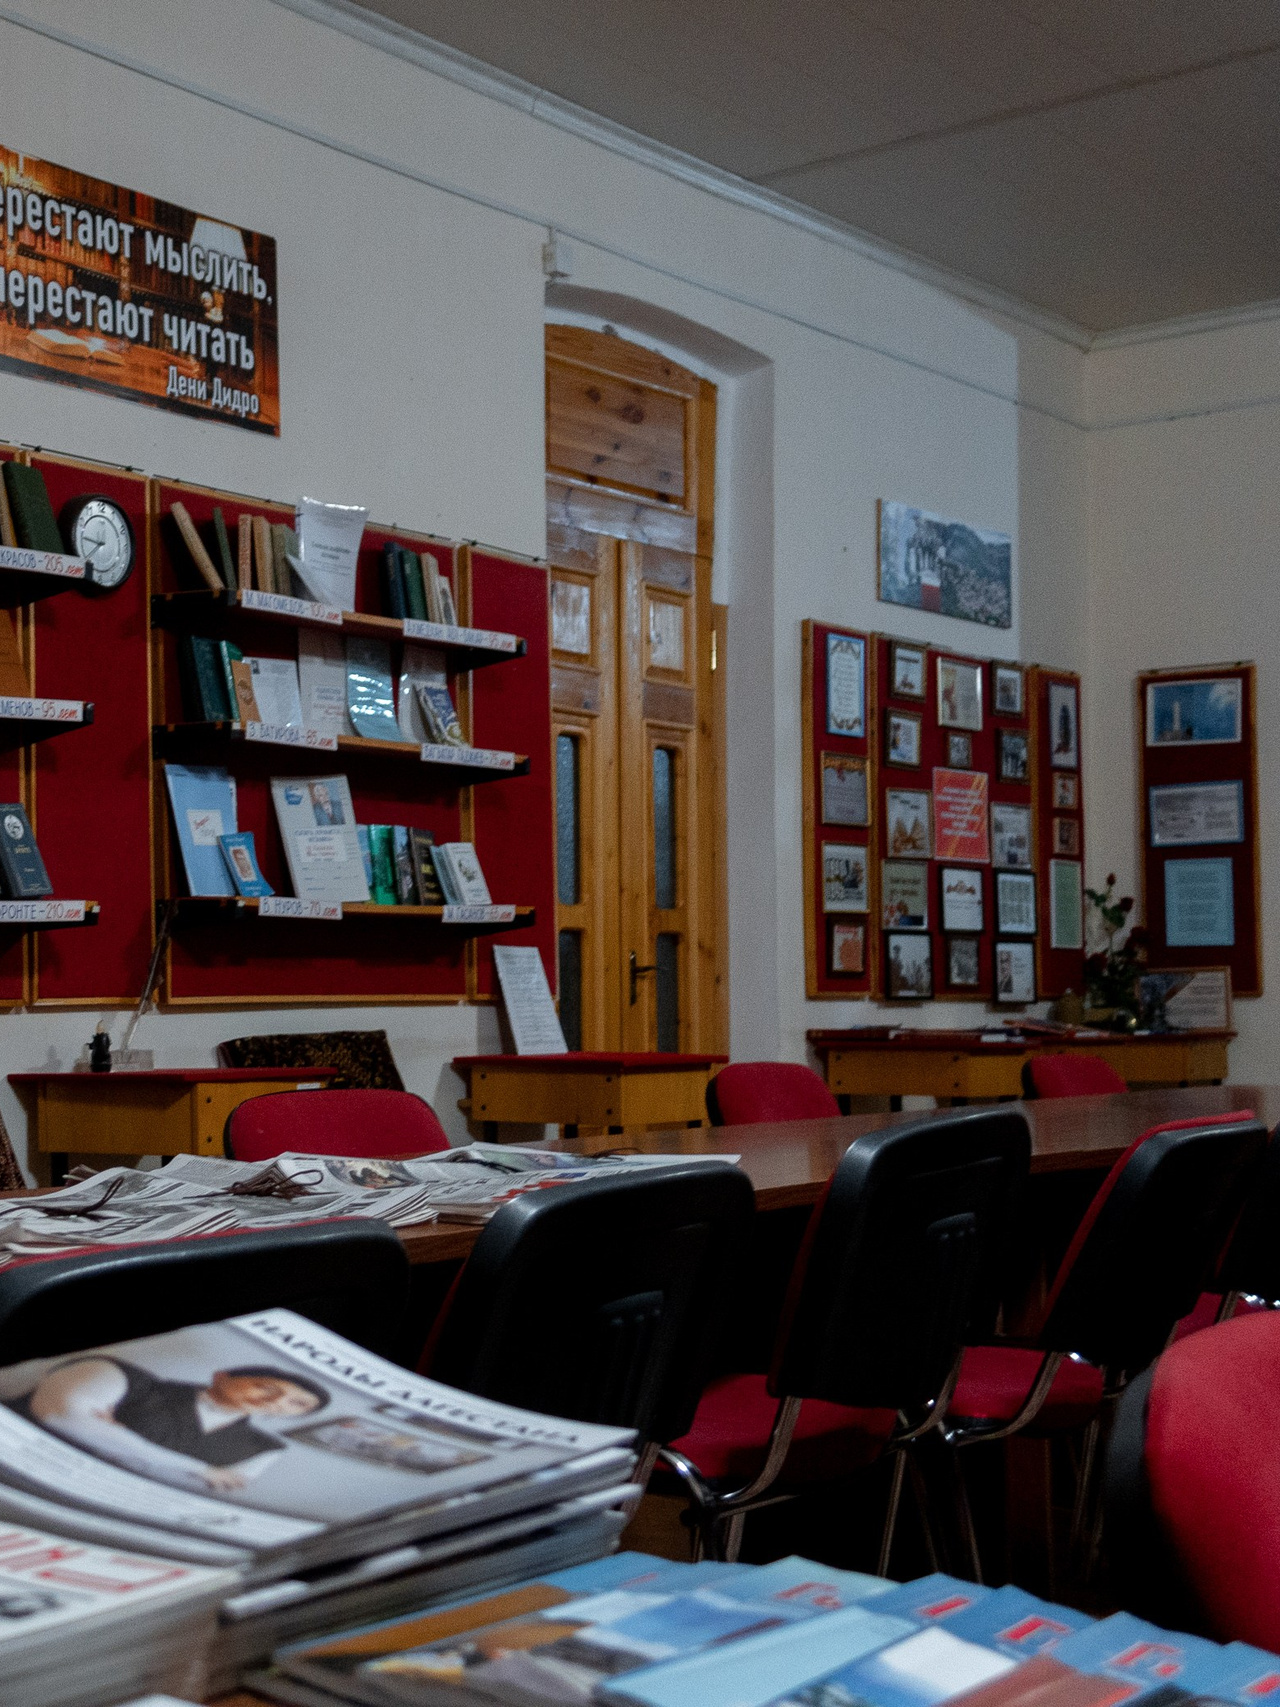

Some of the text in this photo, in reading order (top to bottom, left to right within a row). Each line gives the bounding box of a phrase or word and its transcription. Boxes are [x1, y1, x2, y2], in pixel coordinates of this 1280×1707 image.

[145, 234, 274, 305] мыслить,
[163, 315, 255, 371] читать
[166, 365, 259, 415] Дени Дидро
[65, 563, 84, 576] лет
[57, 708, 79, 720] лет
[64, 909, 82, 919] лет
